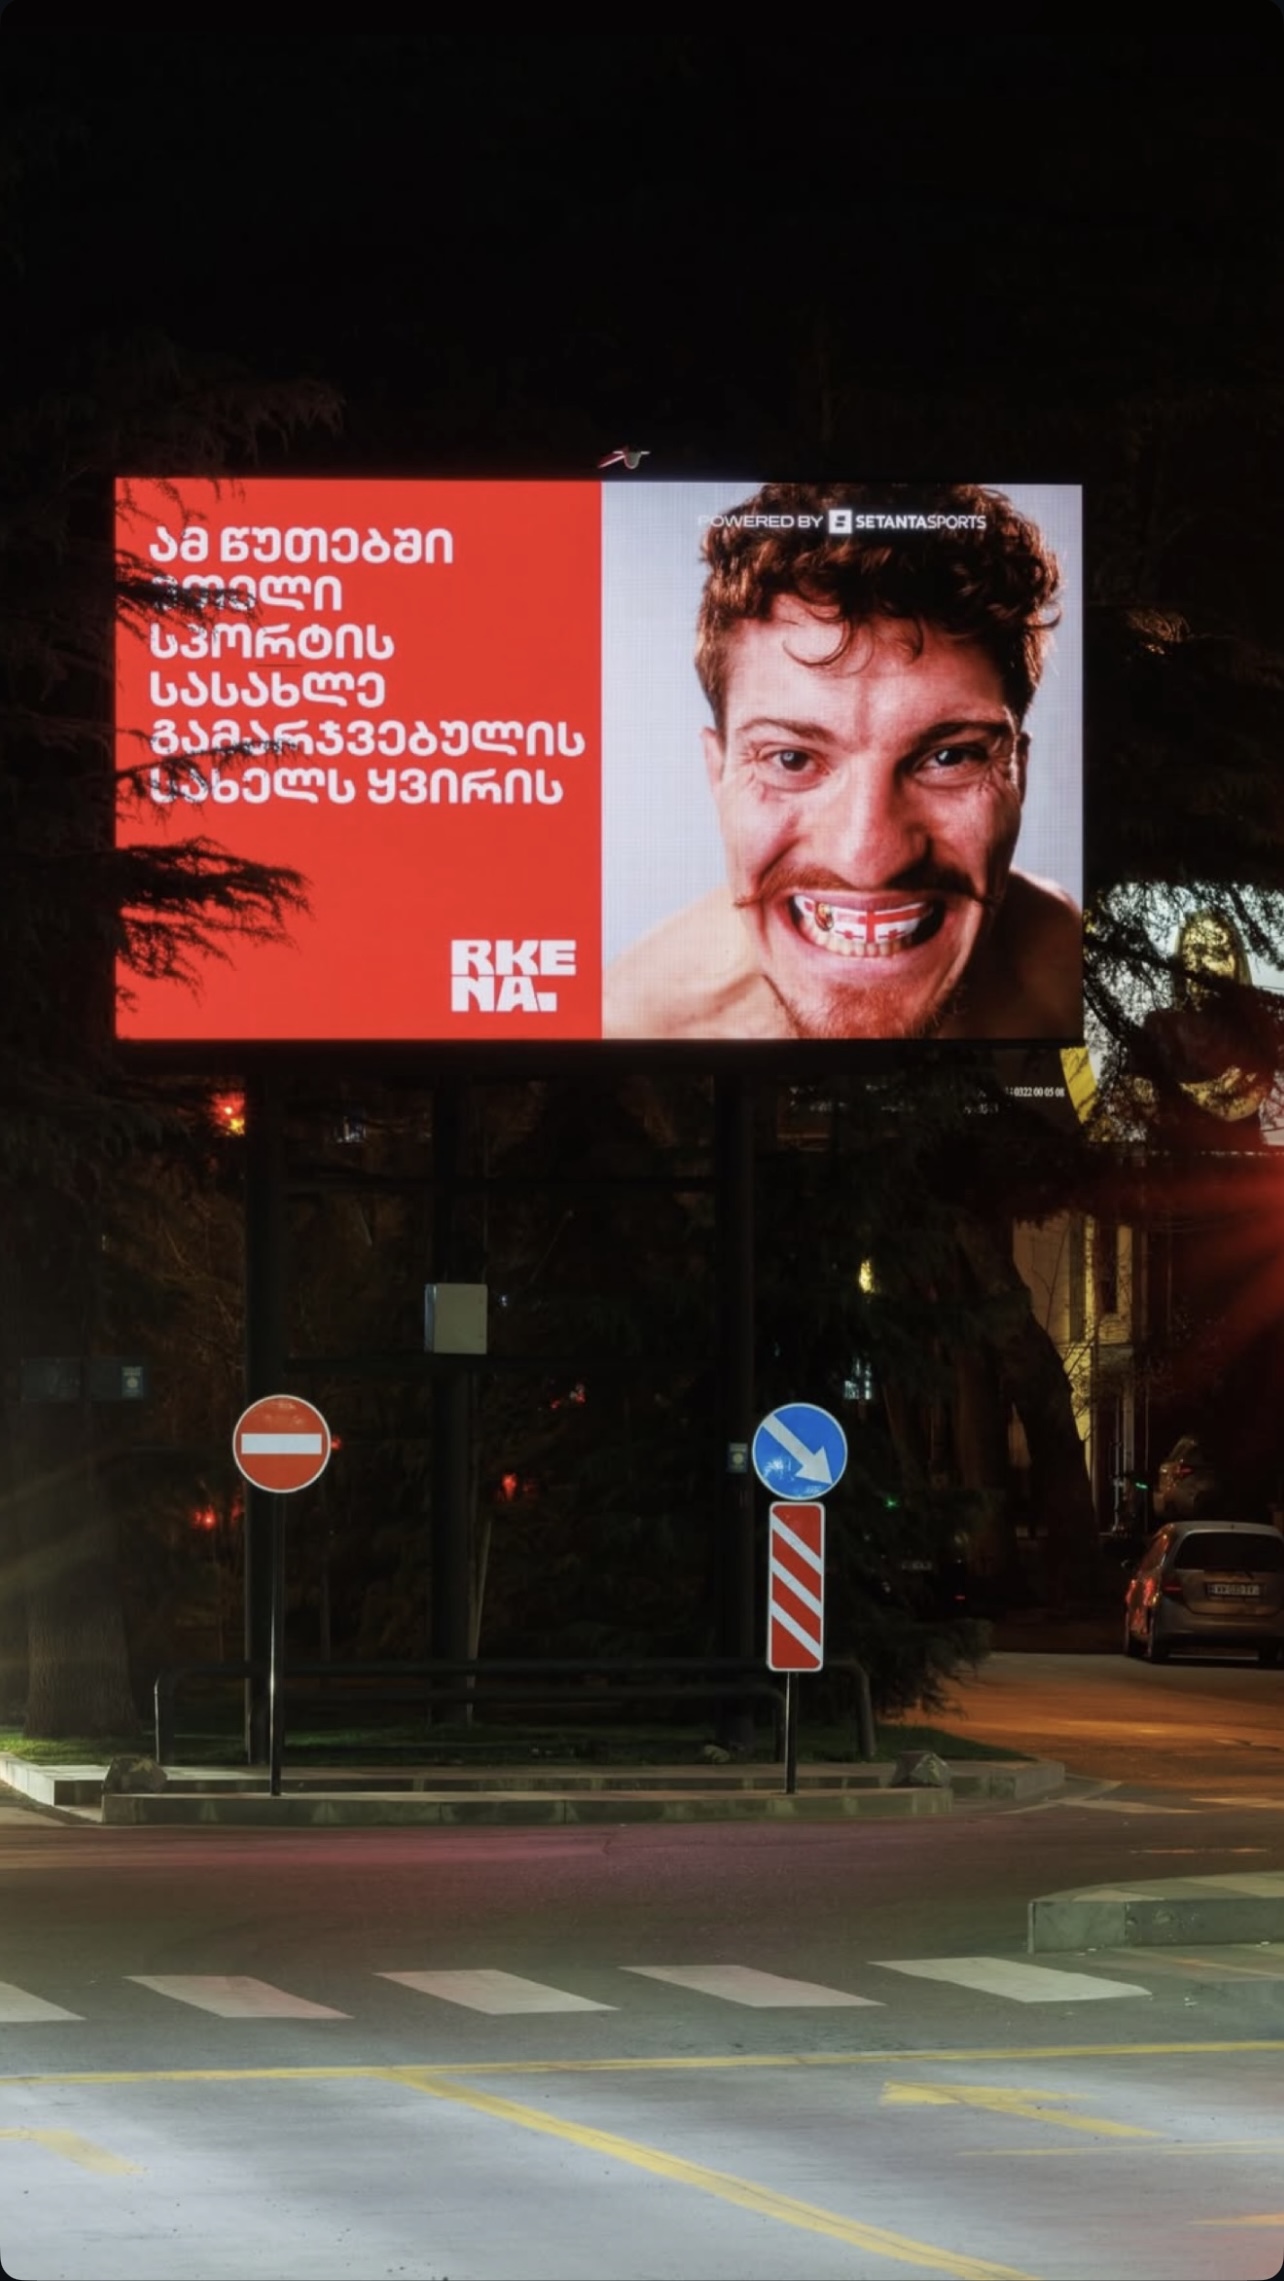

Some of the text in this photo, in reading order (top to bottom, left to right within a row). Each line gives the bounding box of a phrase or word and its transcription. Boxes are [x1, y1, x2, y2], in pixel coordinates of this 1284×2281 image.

[698, 515, 987, 529] POWERED BY SETANTASPORTS
[149, 527, 453, 563] ამ წუთებში
[150, 623, 394, 660] სპორტის
[150, 671, 386, 708] სასახლე
[150, 719, 585, 757] გამარჯვებულის
[150, 768, 564, 804] სახელს ყვირის
[451, 940, 577, 976] RKE
